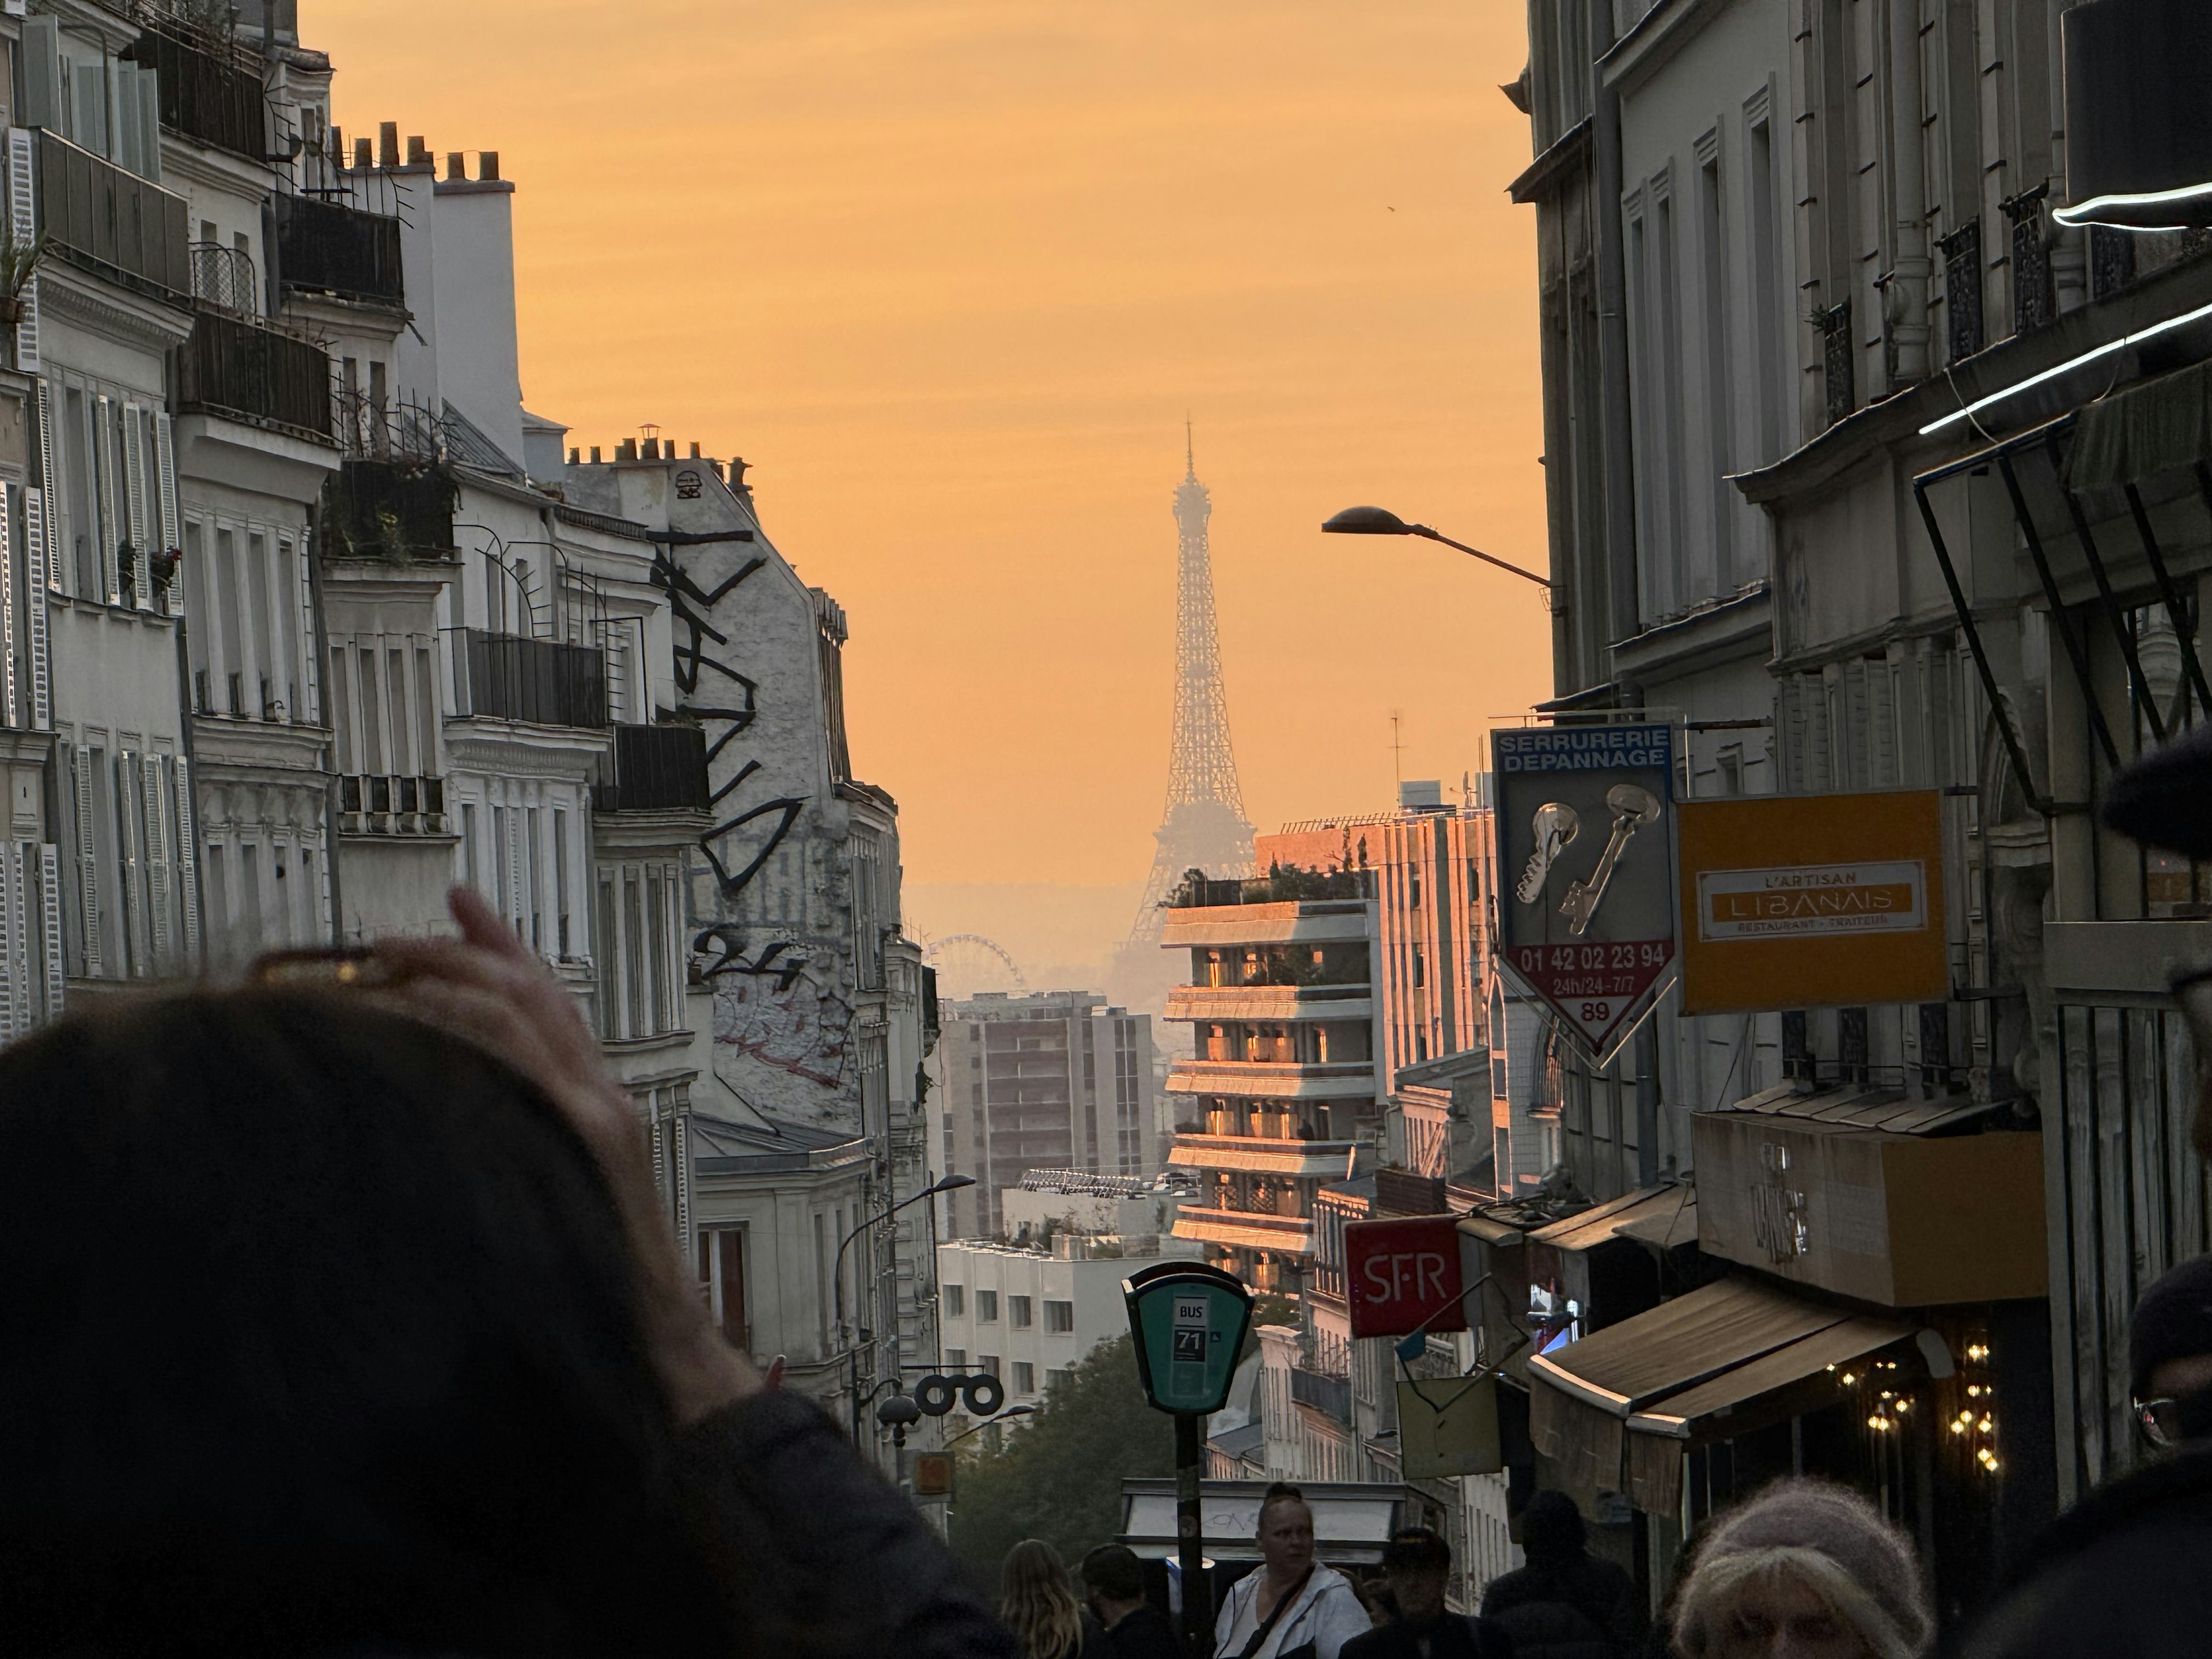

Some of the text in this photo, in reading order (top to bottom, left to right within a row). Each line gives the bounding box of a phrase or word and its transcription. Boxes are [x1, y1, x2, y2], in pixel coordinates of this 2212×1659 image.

[1499, 729, 1669, 753] SERRURERIE
[1504, 749, 1665, 772] DEPANNAGE
[1765, 872, 1857, 888] L'ARTISAN
[1731, 889, 1892, 916] LIBANAIS
[1521, 944, 1665, 972] 01 42 02 23 94
[1581, 1002, 1610, 1022] 89
[1364, 1252, 1448, 1304] SFR
[1180, 1306, 1203, 1318] BUS
[1178, 1332, 1200, 1349] 71
